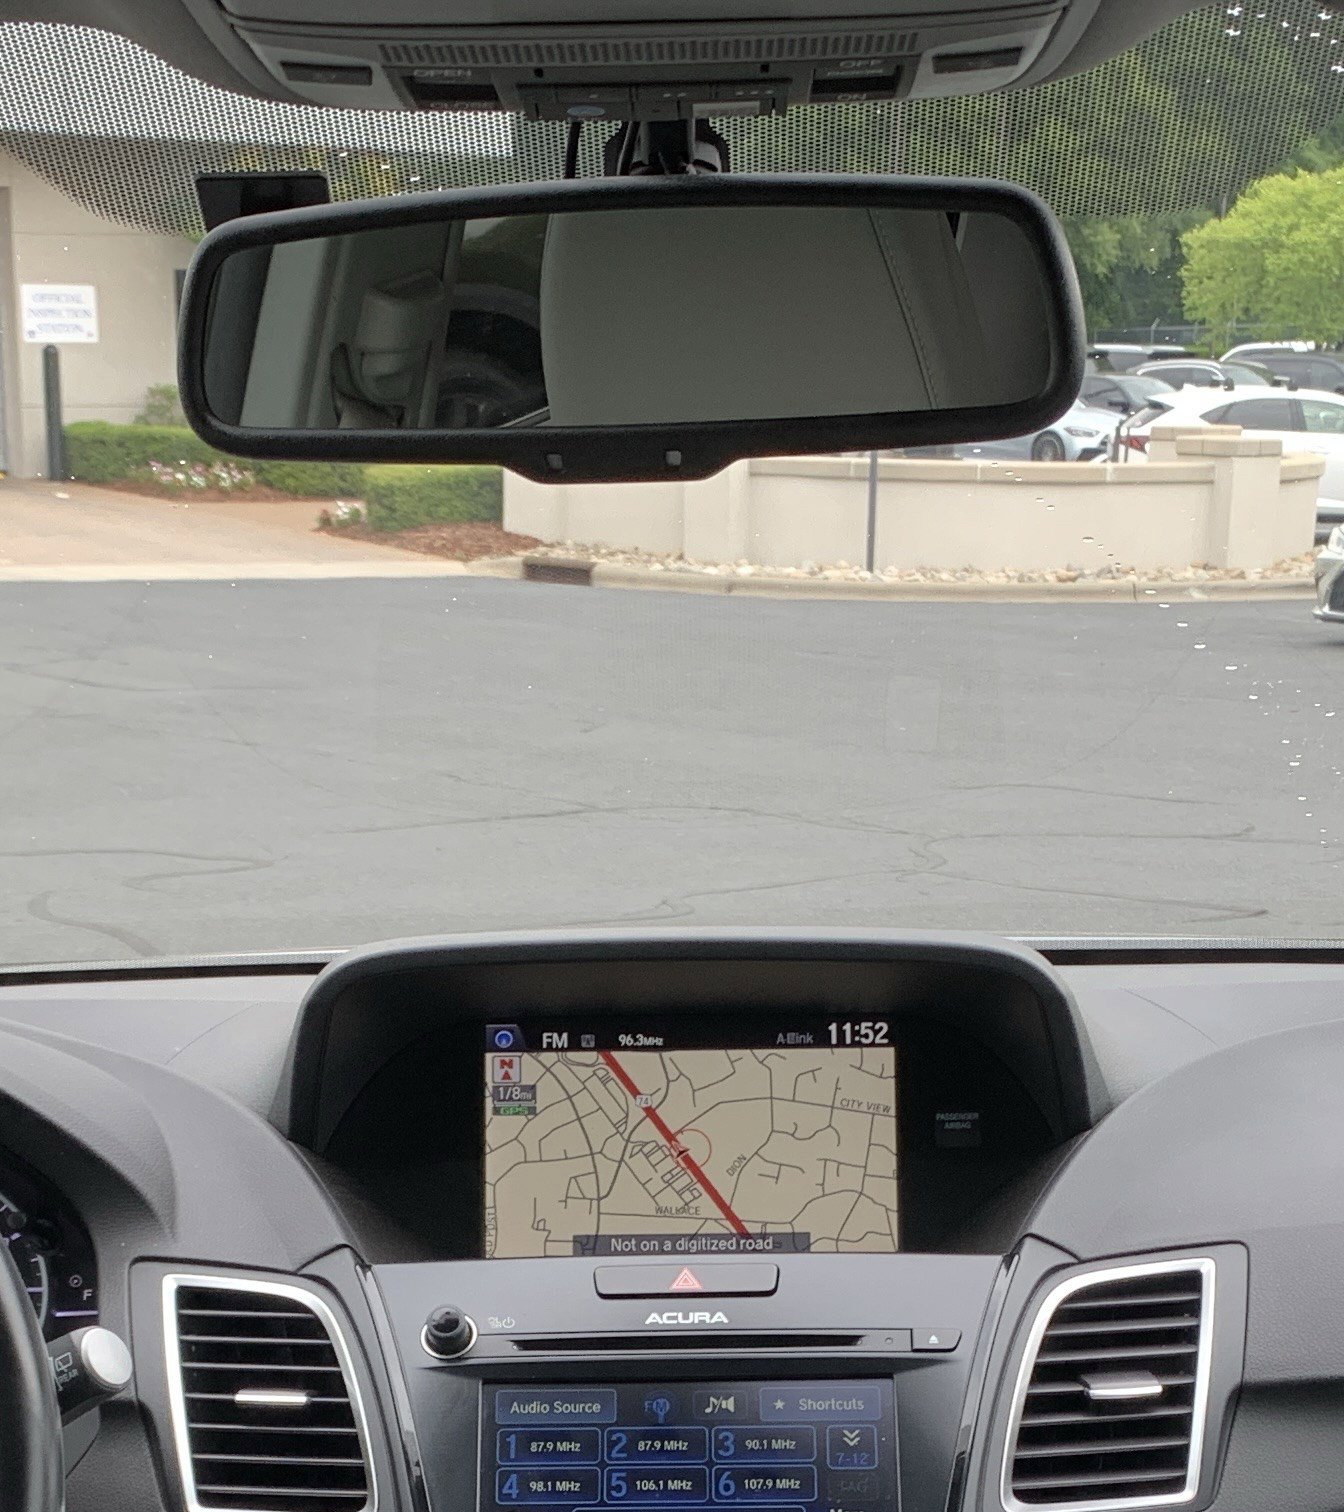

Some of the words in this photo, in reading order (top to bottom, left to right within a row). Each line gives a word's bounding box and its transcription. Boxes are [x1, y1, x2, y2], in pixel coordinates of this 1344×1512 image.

[542, 1031, 569, 1049] FM
[828, 1021, 890, 1045] 11:52
[499, 1058, 514, 1069] N
[636, 1096, 650, 1106] 74
[839, 1097, 864, 1109] CITY
[865, 1099, 892, 1114] VIEW
[499, 1106, 529, 1116] GPS
[726, 1153, 748, 1178] DION
[655, 1205, 701, 1216] WALLACE
[611, 1237, 637, 1252] Not
[640, 1239, 659, 1251] on
[662, 1240, 672, 1251] a
[675, 1236, 737, 1253] digitized
[739, 1235, 774, 1251] road
[83, 1289, 93, 1301] F
[644, 1311, 729, 1325] ACURA
[510, 1402, 550, 1415] Audio
[553, 1401, 602, 1414] Source
[798, 1397, 865, 1412] Shortcuts
[506, 1434, 518, 1459] 1
[530, 1441, 554, 1453] 87.9
[556, 1441, 581, 1453] MHz
[610, 1432, 628, 1458] 2
[637, 1440, 661, 1452] 87.9
[663, 1440, 689, 1452] MHz
[718, 1431, 735, 1457] 3
[745, 1438, 768, 1450] 90.1
[771, 1438, 796, 1450] MHz
[836, 1452, 871, 1465] 7-12
[501, 1474, 519, 1499] 4
[529, 1481, 553, 1493] 98.1
[555, 1481, 581, 1493] MHz
[610, 1472, 628, 1498] 5
[635, 1480, 664, 1491] 106.1
[667, 1479, 693, 1491] MHz
[718, 1471, 736, 1497] 6
[744, 1478, 773, 1490] 107.9
[775, 1478, 801, 1490] MHz
